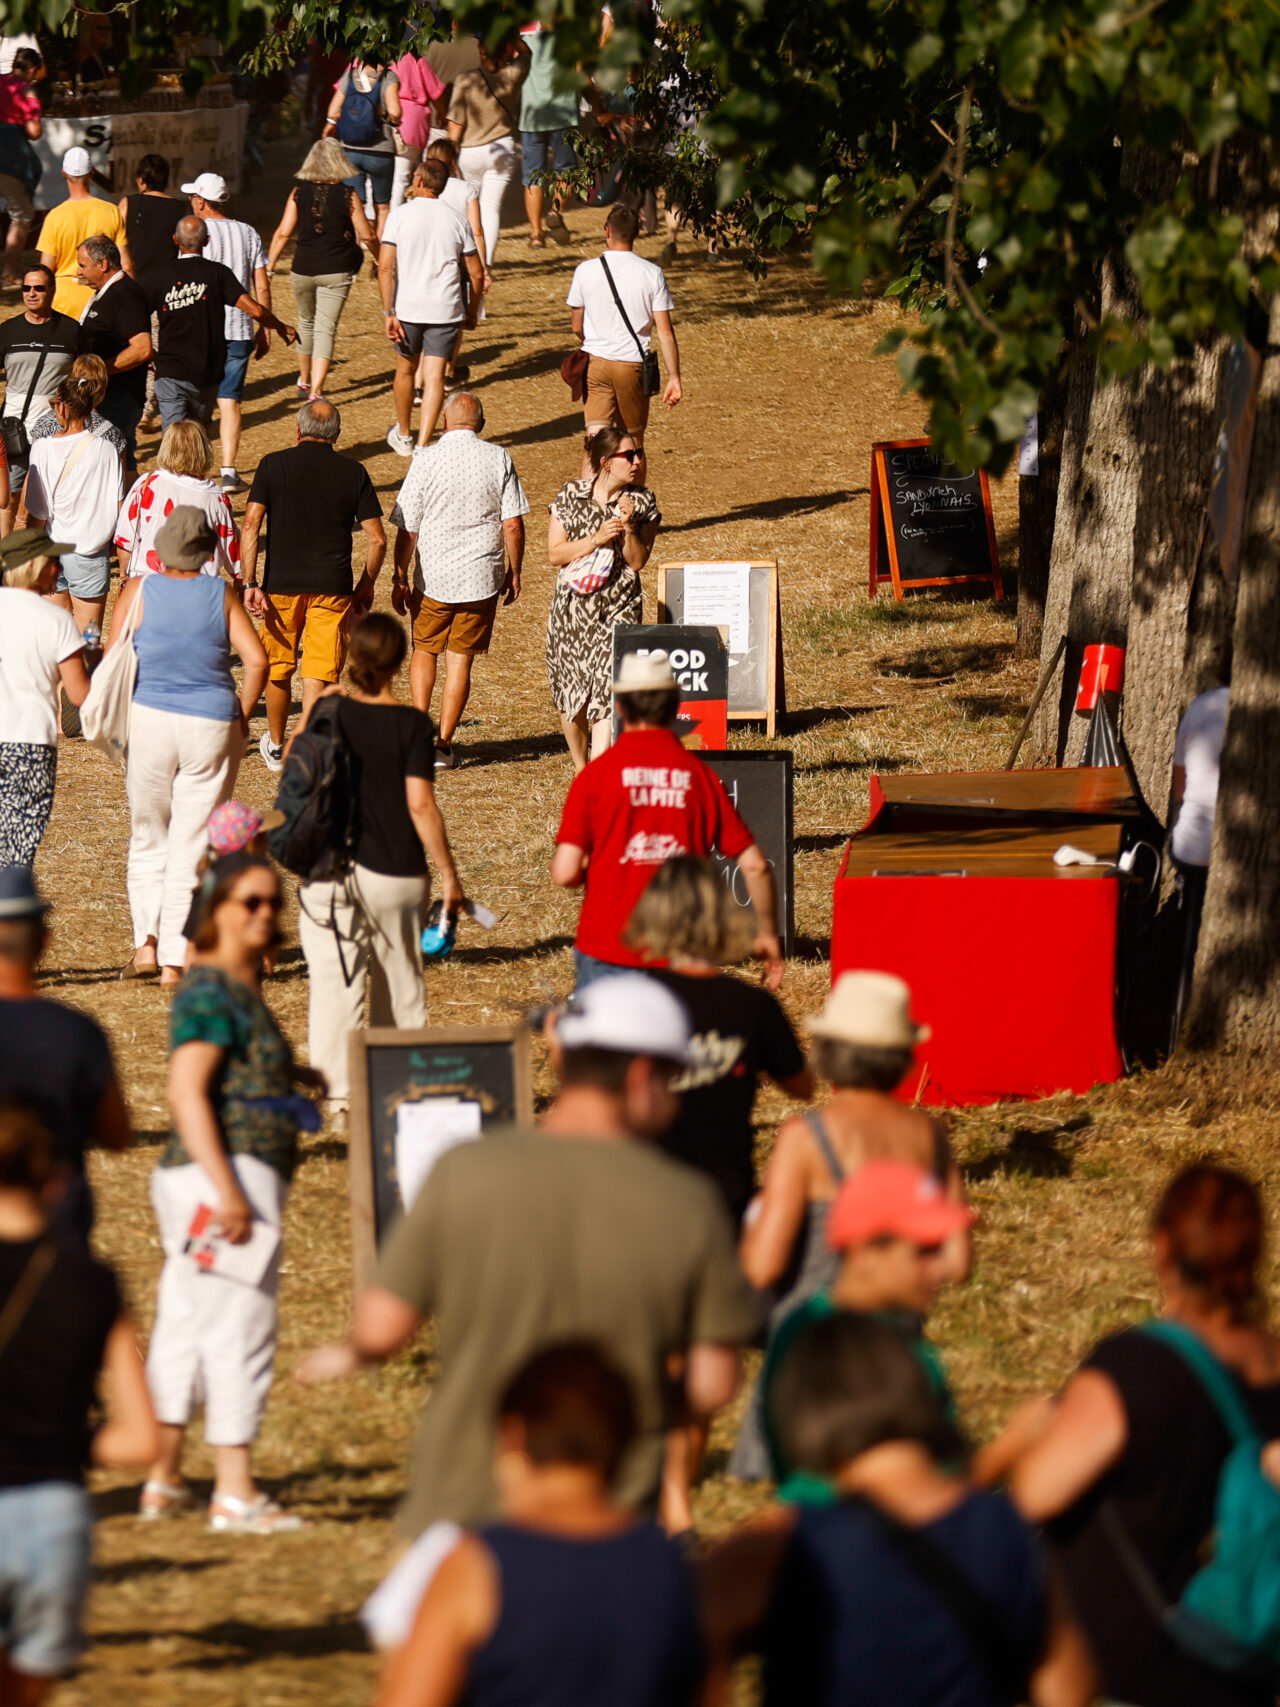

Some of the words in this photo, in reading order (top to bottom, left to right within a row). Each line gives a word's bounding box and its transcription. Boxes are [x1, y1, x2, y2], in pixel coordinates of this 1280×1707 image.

[168, 295, 195, 311] TEAM
[621, 766, 669, 788] REINE
[670, 768, 692, 791] DE
[629, 787, 649, 807] LA
[649, 787, 687, 809] PITE
